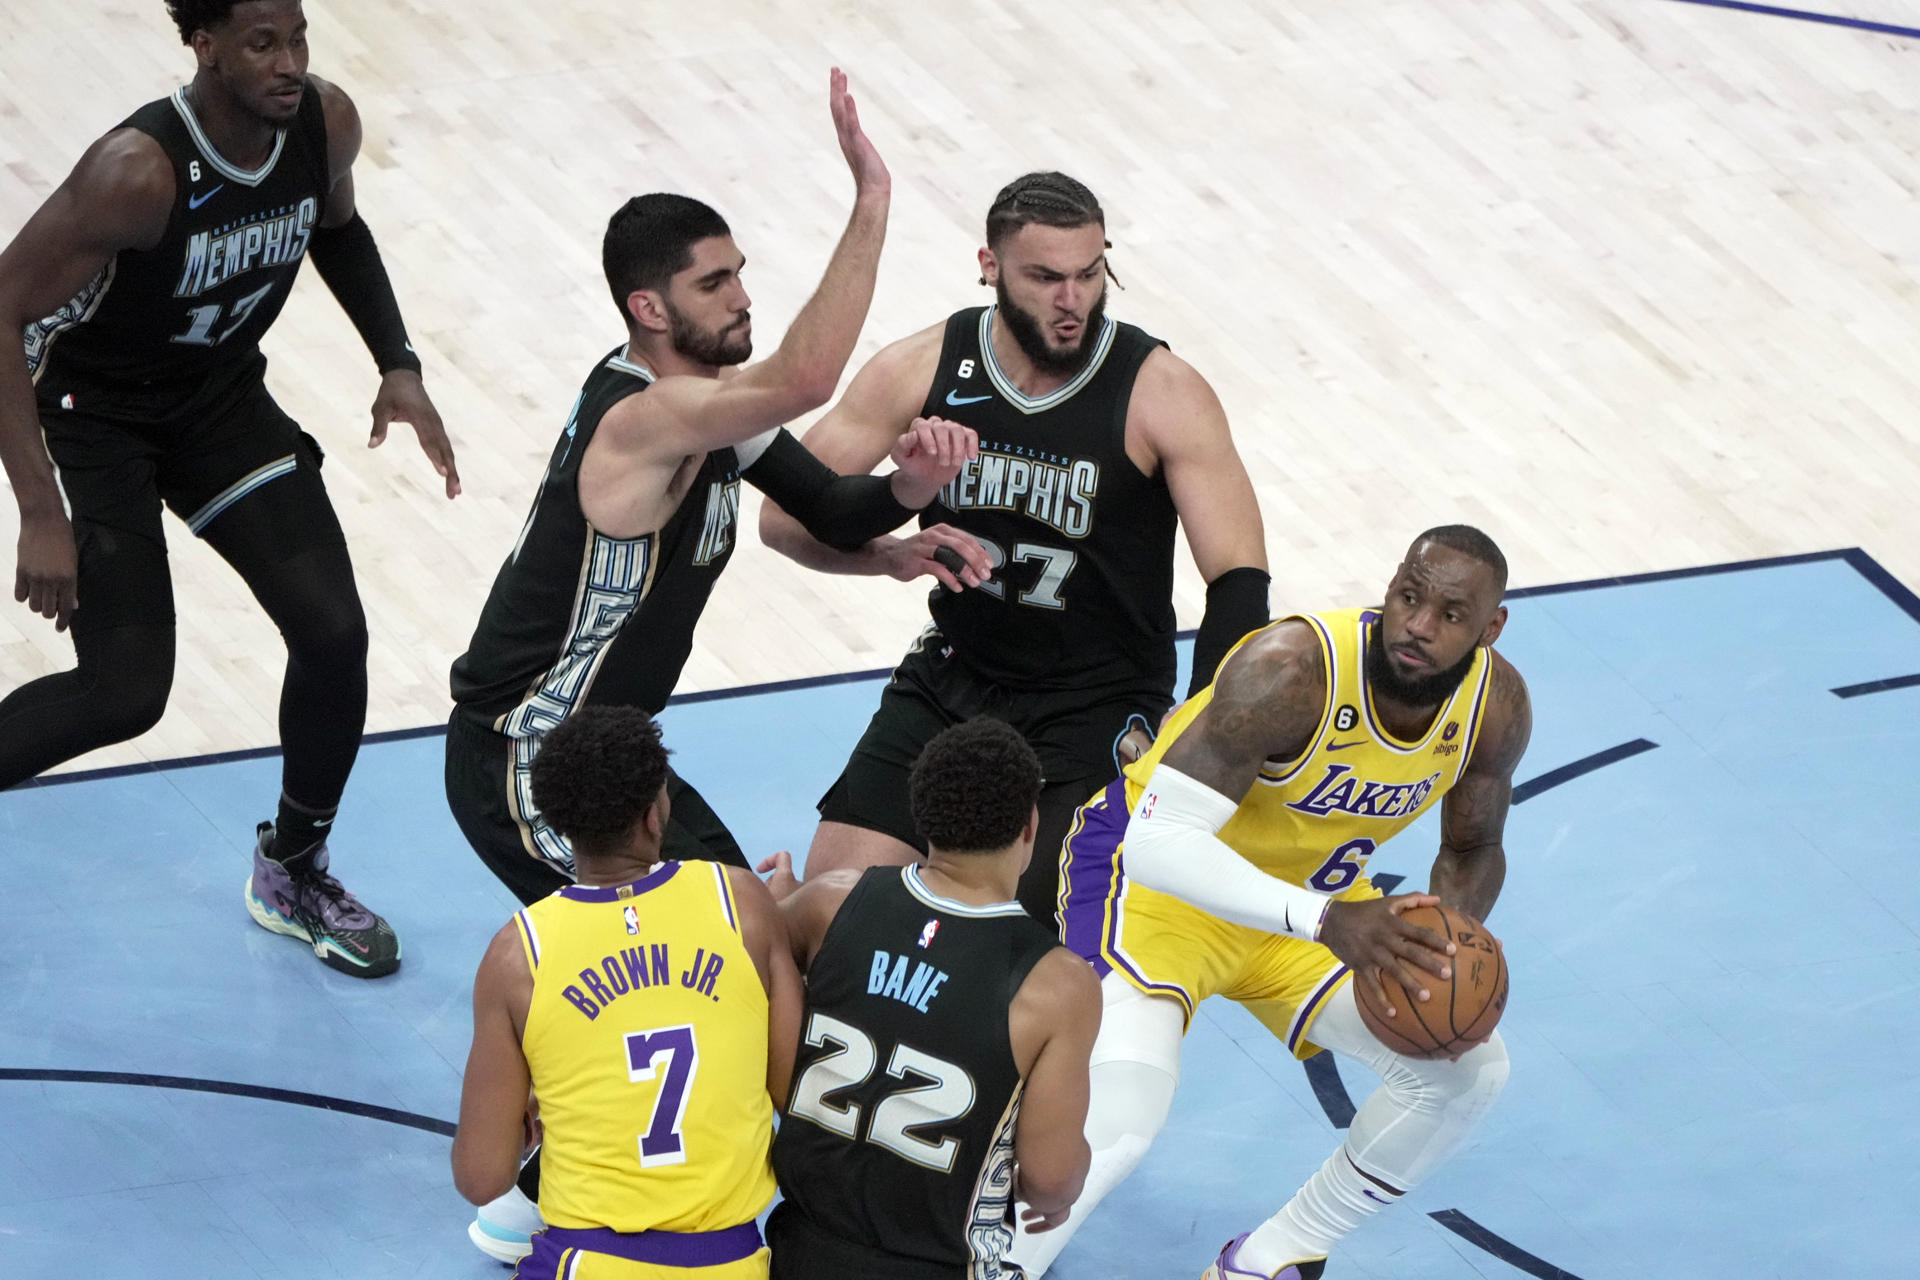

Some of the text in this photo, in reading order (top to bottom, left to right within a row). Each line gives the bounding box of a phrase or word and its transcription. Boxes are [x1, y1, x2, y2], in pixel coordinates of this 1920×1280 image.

[189, 160, 201, 182] 6
[173, 195, 317, 298] MEMPHIS
[957, 358, 975, 379] 6
[979, 440, 1069, 465] RIZZLIES
[1337, 708, 1353, 729] 6
[1283, 763, 1443, 818] LAKERS
[1304, 837, 1378, 895] 6
[561, 943, 724, 1021] BROWN JR.
[867, 950, 949, 1014] BANE
[623, 1023, 700, 1169] 7
[788, 1012, 977, 1174] 22
